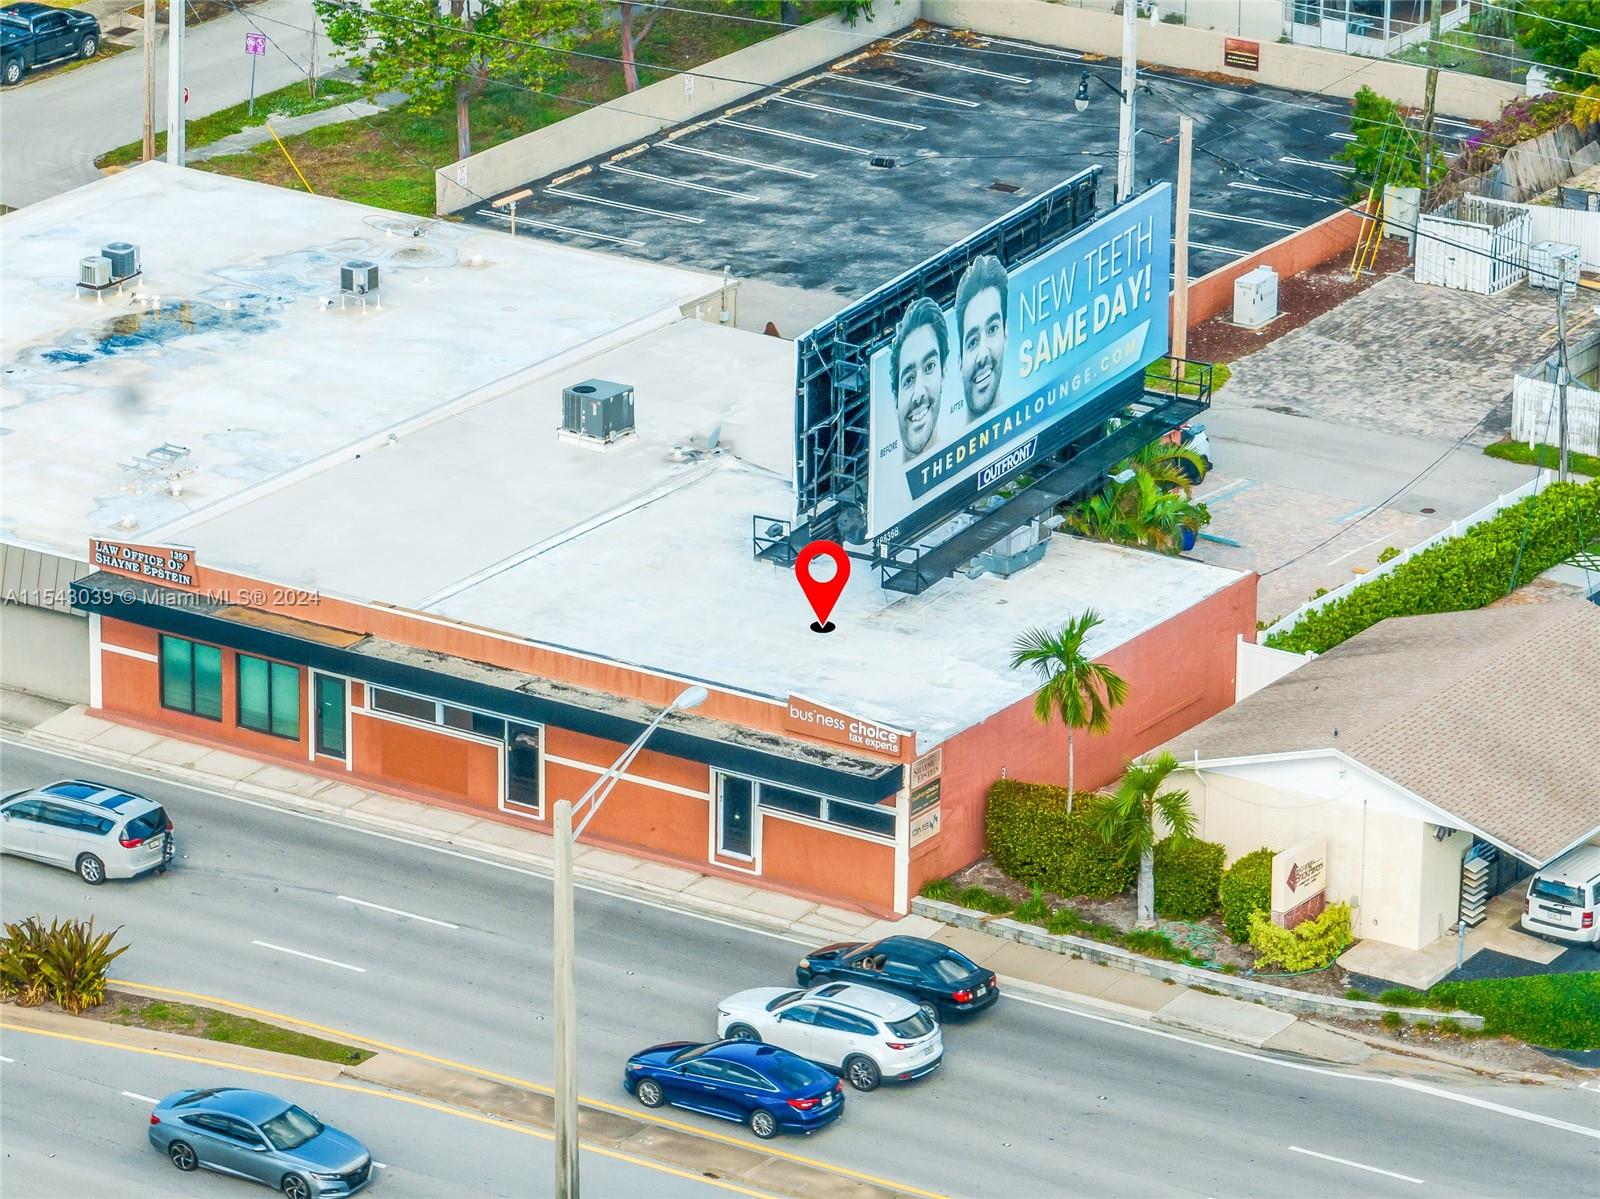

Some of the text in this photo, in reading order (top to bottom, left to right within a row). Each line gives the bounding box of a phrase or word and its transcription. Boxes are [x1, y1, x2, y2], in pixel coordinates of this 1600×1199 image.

[1019, 215, 1154, 332] NEW TEETH
[1019, 264, 1153, 379] SAME DAY!
[920, 337, 1140, 485] THEDENTALLOUNGE.COM
[950, 400, 964, 413] AFTER
[880, 440, 898, 458] BEFORE
[983, 443, 1032, 484] OUTFRONT
[95, 540, 184, 571] LAW OFFICE OF
[95, 552, 192, 585] SHAYNE EPSTEIN
[169, 550, 188, 561] 1359
[790, 705, 897, 743] busness choice
[849, 732, 898, 753] tax experts
